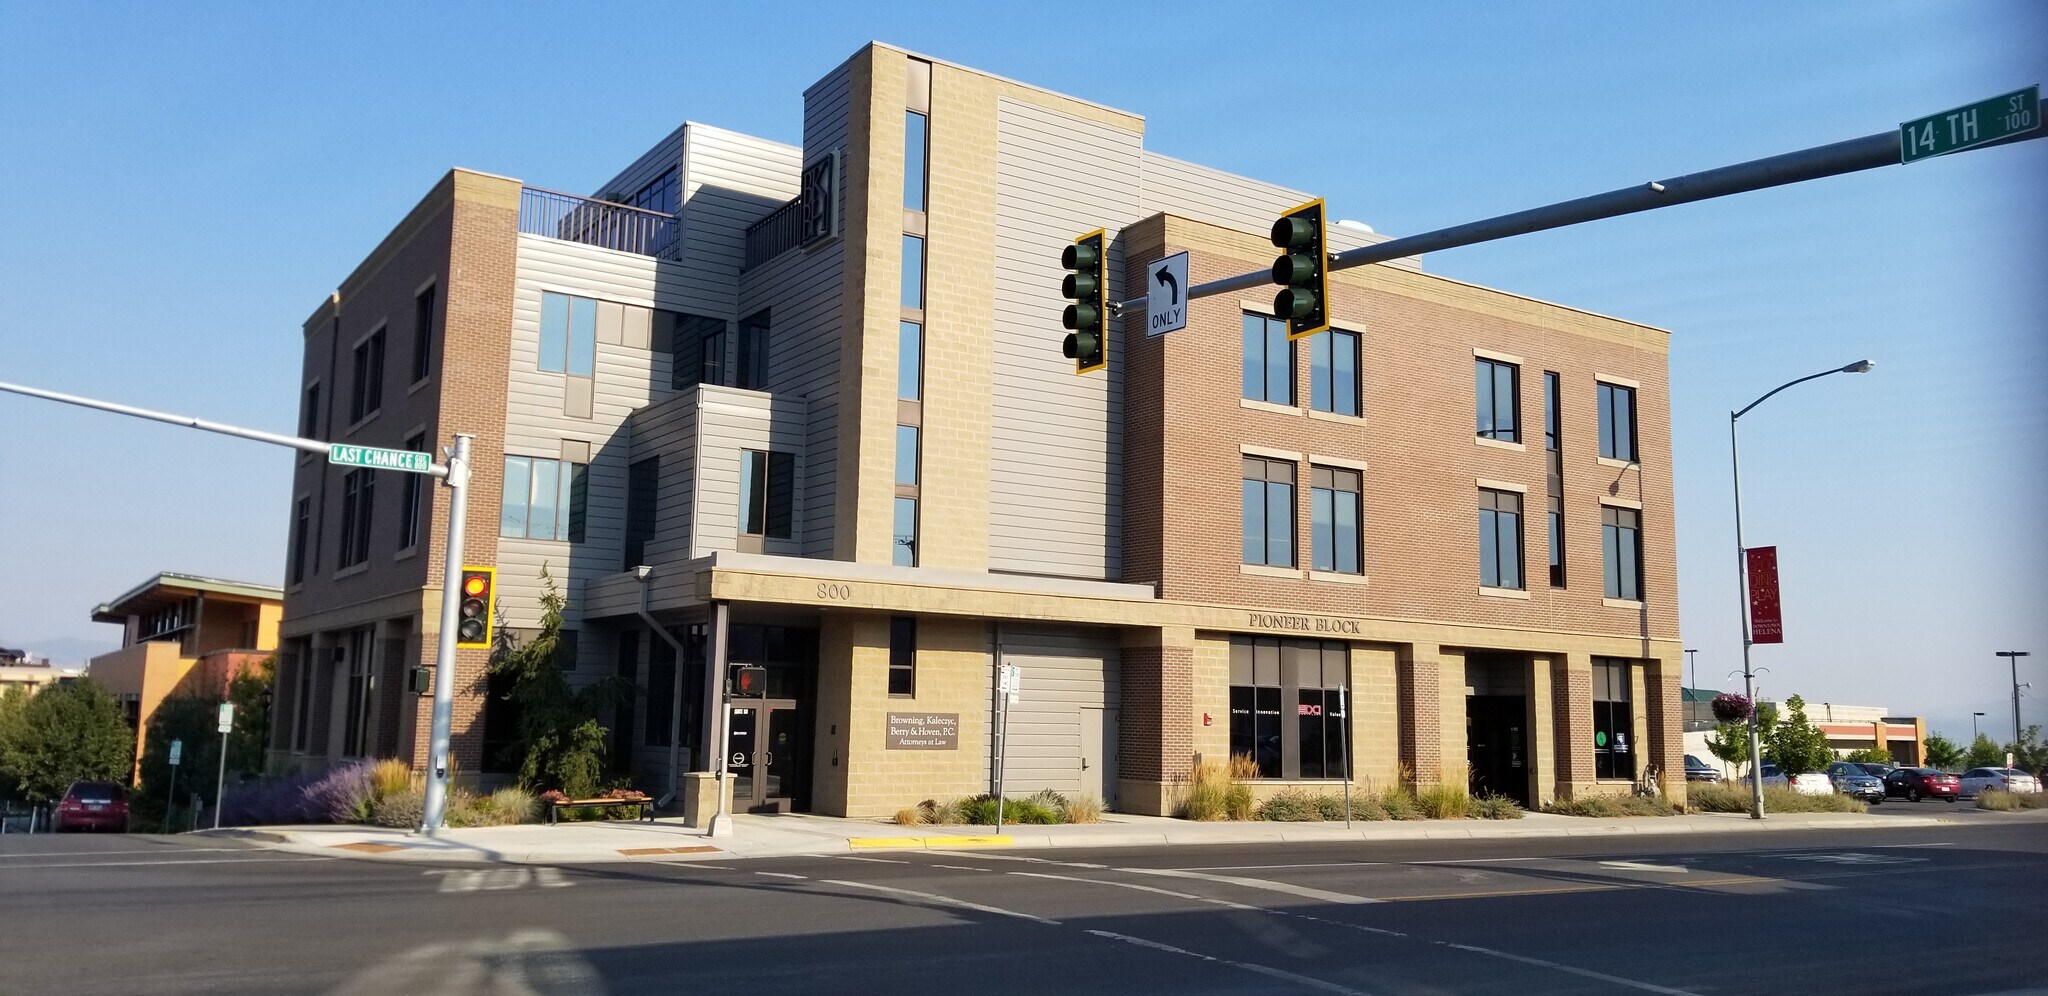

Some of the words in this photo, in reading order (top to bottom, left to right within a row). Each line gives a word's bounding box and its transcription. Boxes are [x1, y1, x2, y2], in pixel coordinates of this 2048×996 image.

[2009, 94, 2024, 113] ST
[2005, 110, 2030, 131] 100
[1908, 121, 1935, 156] 14
[1946, 108, 1978, 145] TH
[1152, 308, 1181, 329] ONLY
[333, 446, 362, 463] LAST
[364, 448, 413, 468] CHANCE
[816, 583, 850, 600] 800
[1750, 588, 1778, 602] PLAY
[1249, 613, 1310, 631] PIONEER
[1315, 618, 1360, 634] BLOCK
[890, 715, 925, 725] Browning,
[926, 716, 957, 726] Kaleczyc,
[890, 727, 909, 737] Berry
[910, 727, 918, 735] &
[918, 727, 942, 736] Hoven,
[943, 727, 956, 735] P.C.
[899, 738, 927, 747] Attorneys
